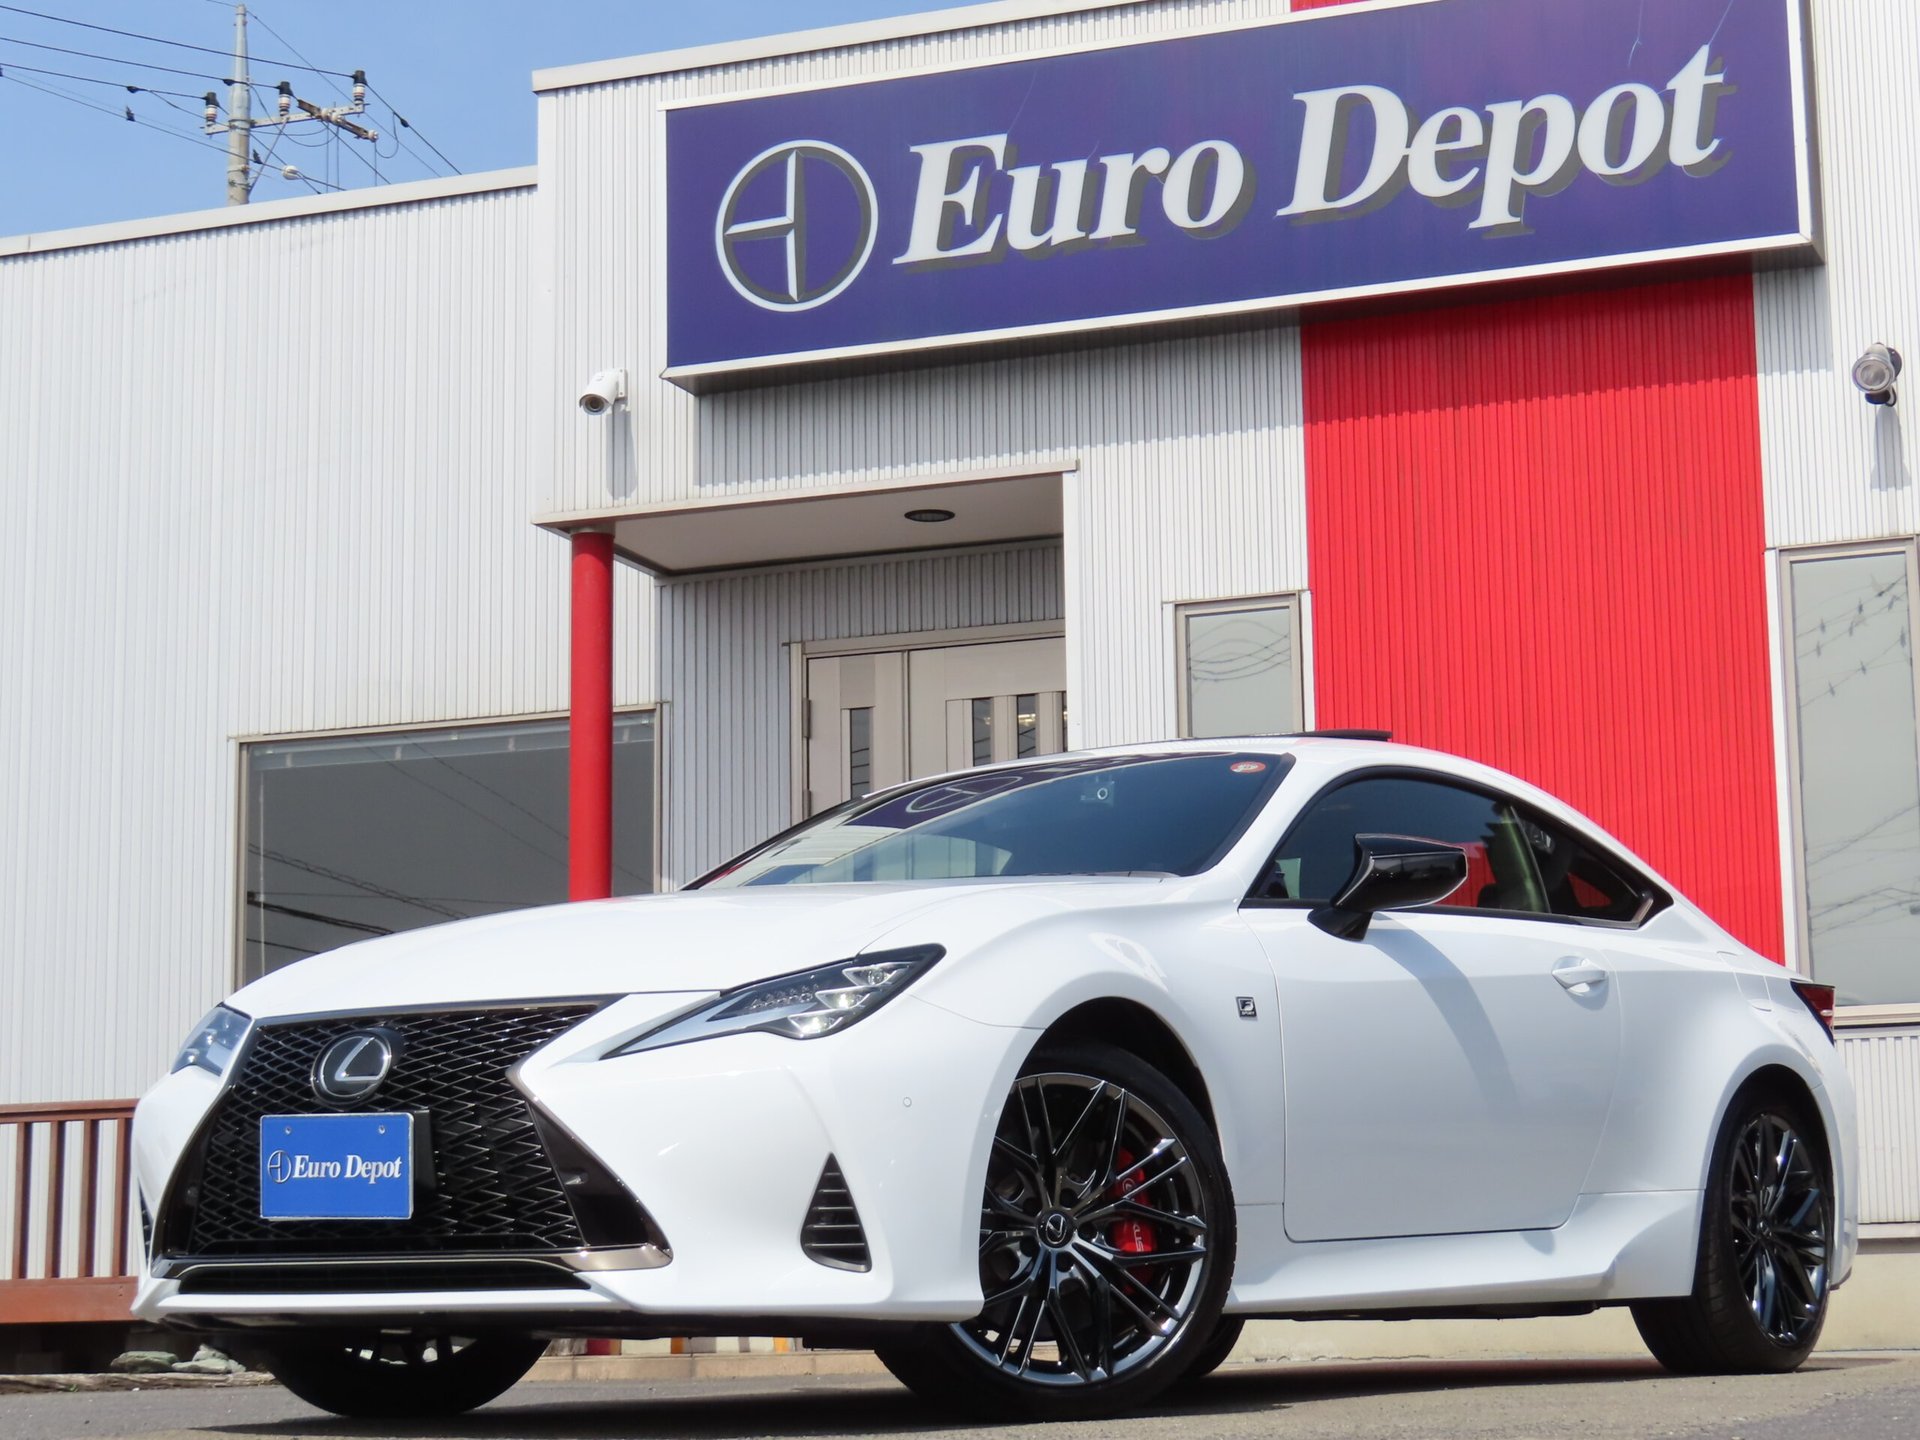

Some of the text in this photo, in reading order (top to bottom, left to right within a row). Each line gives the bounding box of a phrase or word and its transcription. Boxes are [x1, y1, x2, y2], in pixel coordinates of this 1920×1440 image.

[891, 43, 1726, 266] Euro Depot
[292, 1154, 402, 1185] Euro Depot
